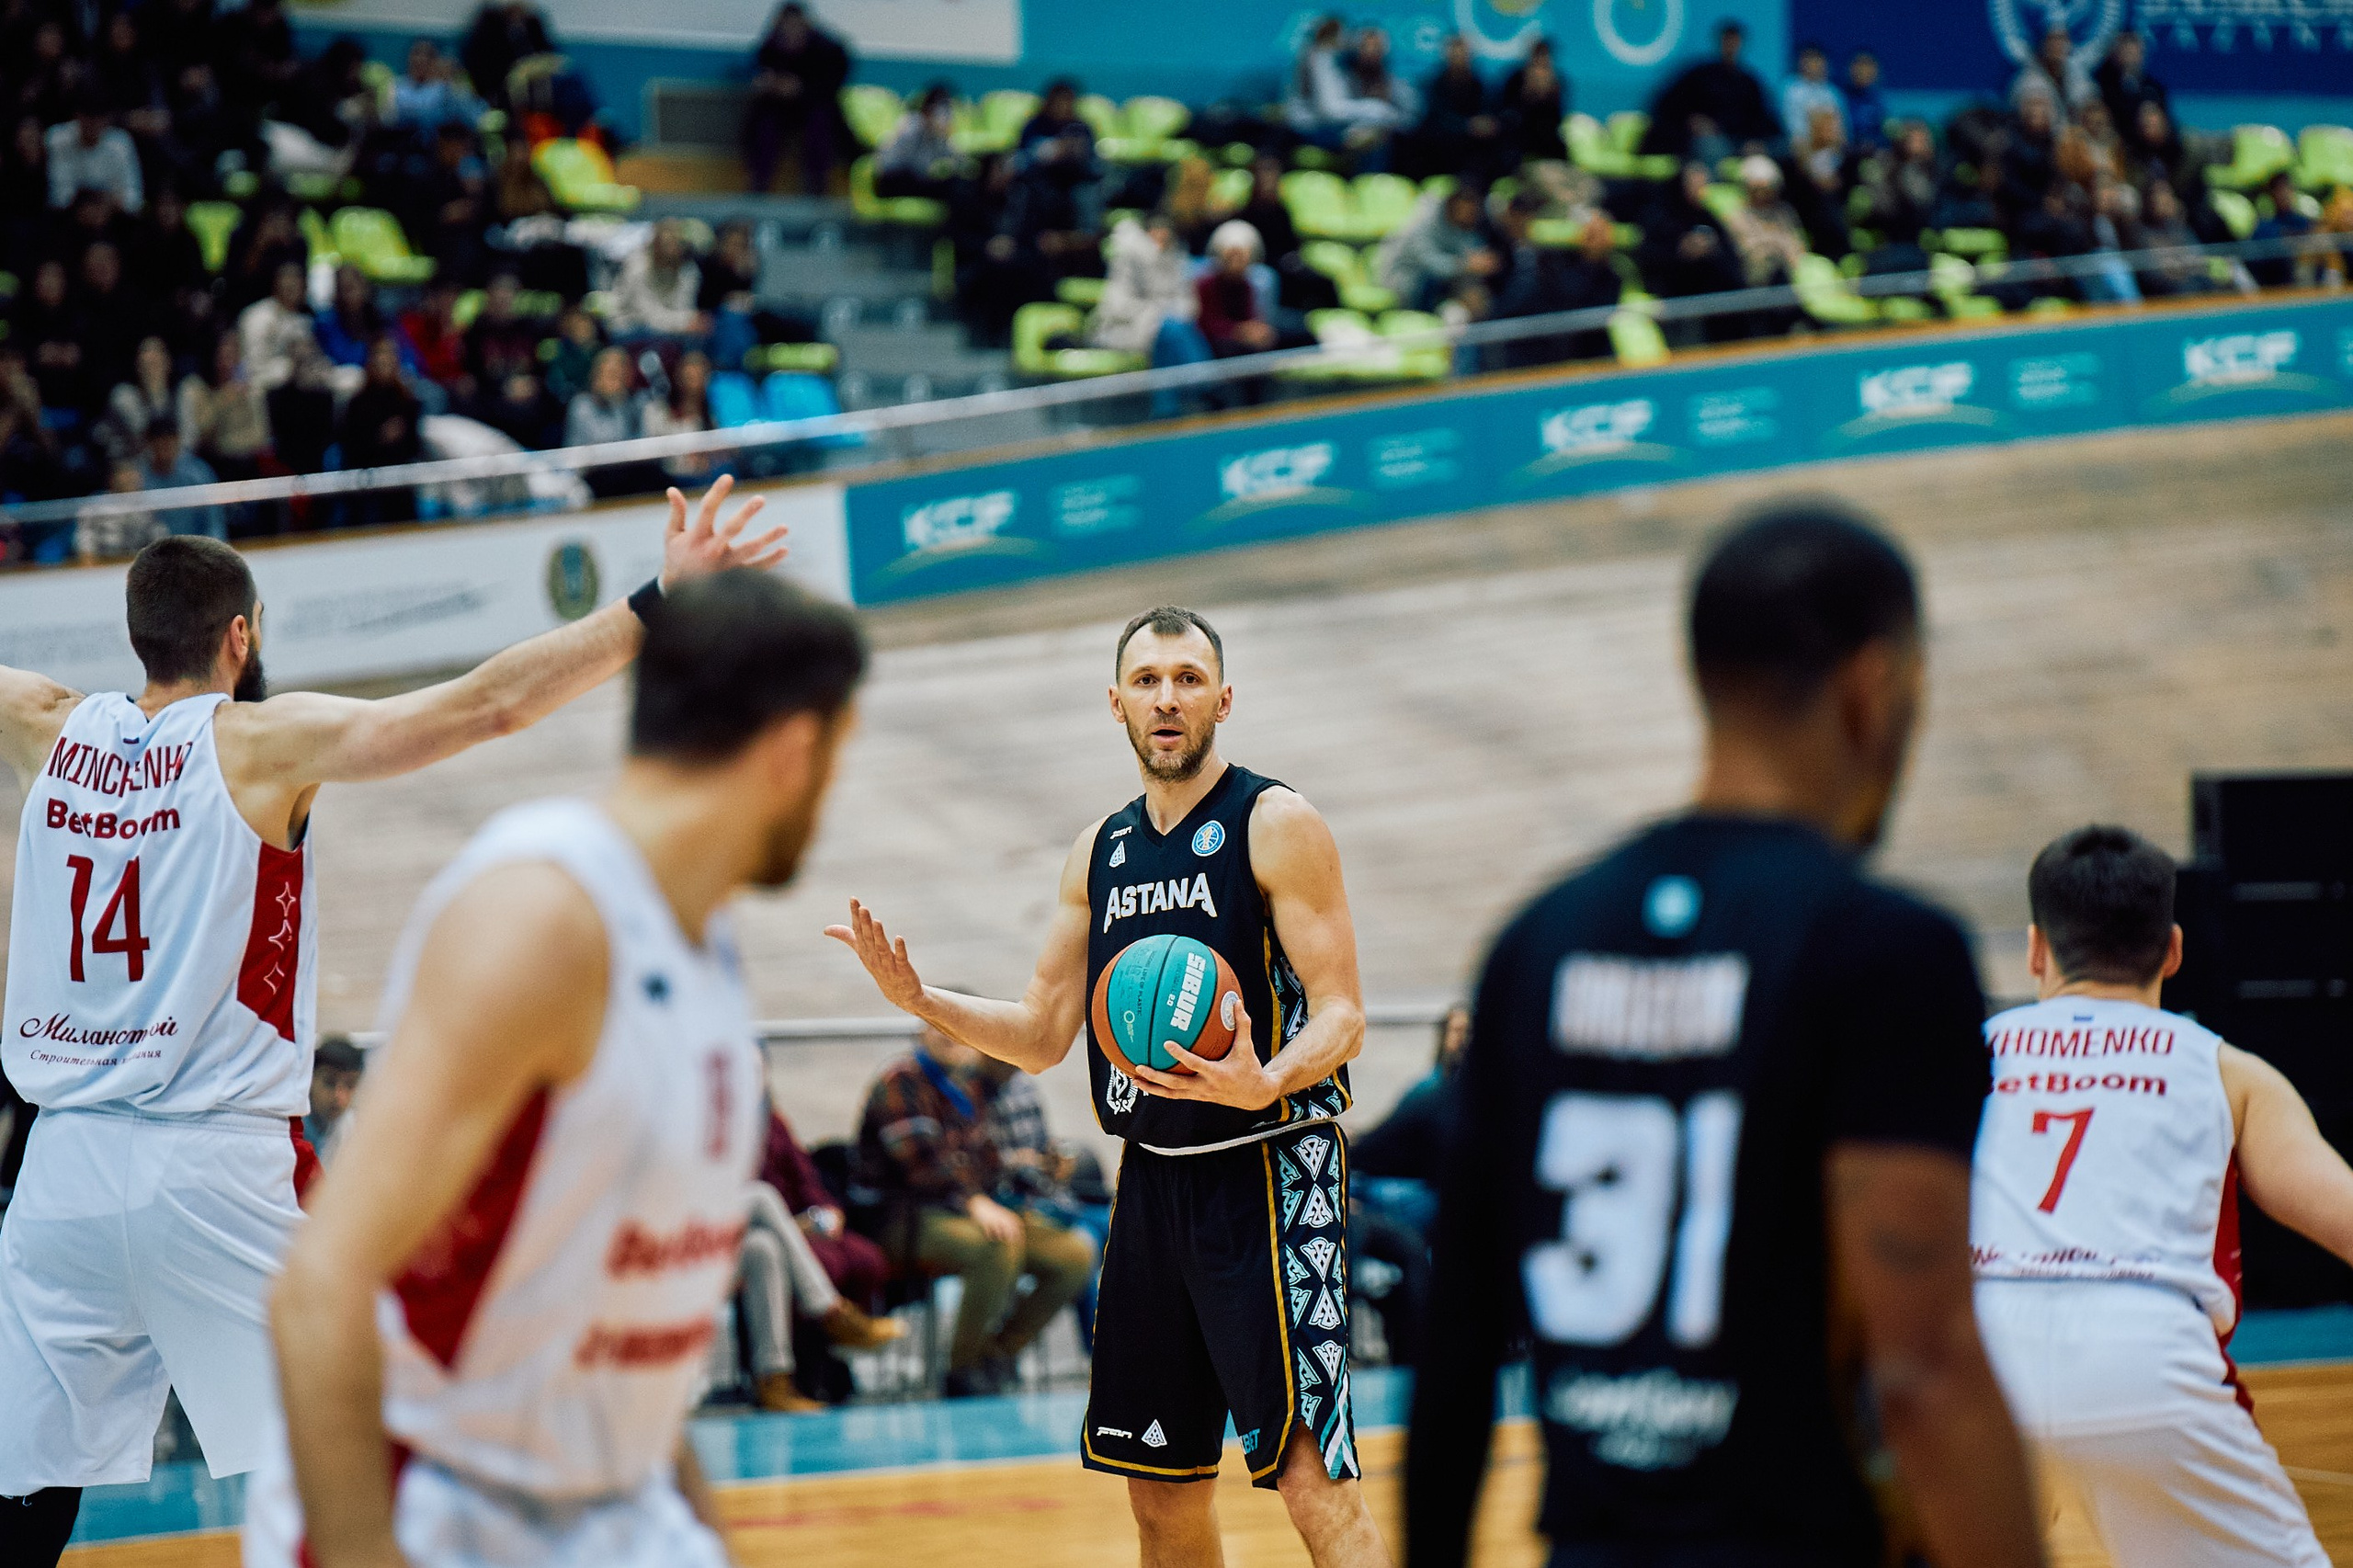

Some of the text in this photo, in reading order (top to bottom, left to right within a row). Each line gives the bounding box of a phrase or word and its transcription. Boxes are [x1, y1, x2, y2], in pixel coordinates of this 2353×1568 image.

[47, 798, 181, 840] BetBoom
[66, 854, 151, 983] 14
[1103, 872, 1218, 934] ASTANA
[1170, 952, 1206, 1032] SIBUR
[19, 1012, 179, 1046] Миланстой
[1996, 1072, 2167, 1096] etBoom
[2031, 1106, 2096, 1215] 7
[1520, 1088, 1744, 1349] 31
